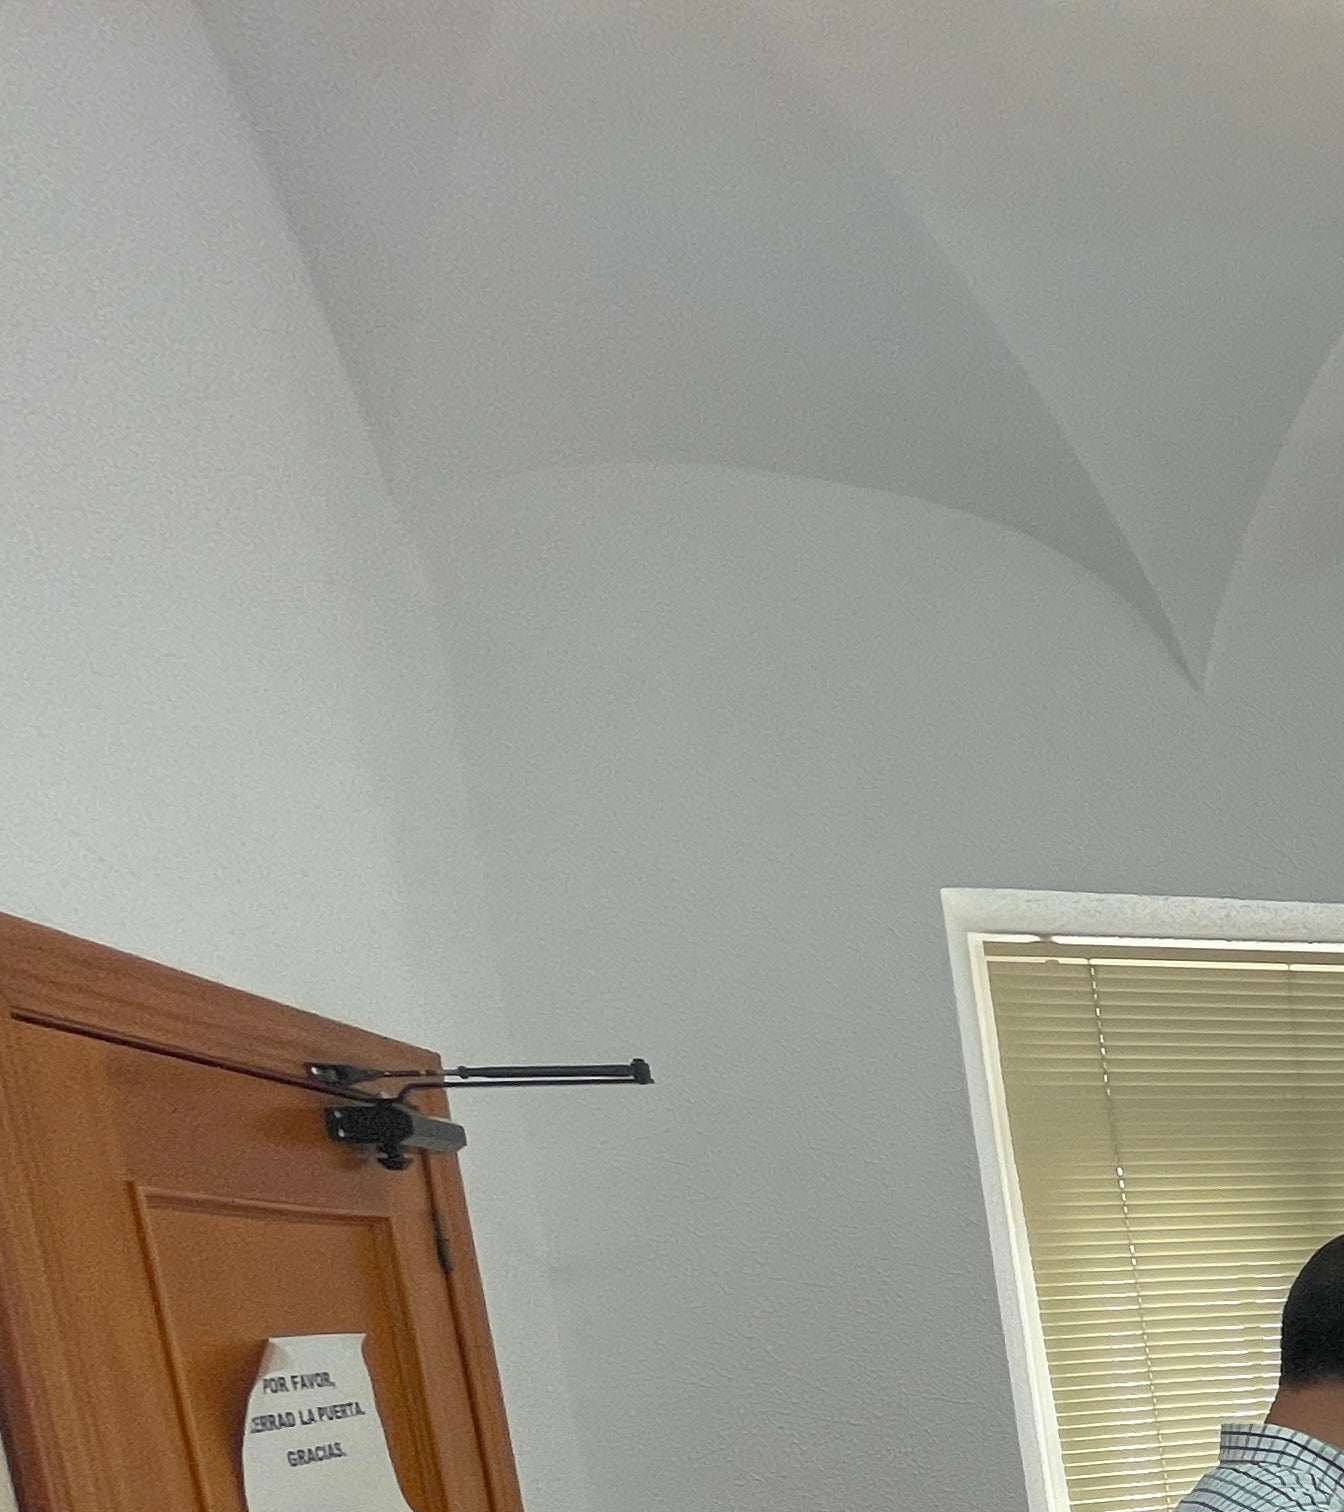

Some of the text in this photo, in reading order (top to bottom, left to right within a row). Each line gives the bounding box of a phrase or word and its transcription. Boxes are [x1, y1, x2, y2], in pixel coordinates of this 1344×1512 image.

[262, 1376, 289, 1394] POR
[250, 1412, 296, 1434] ERRAD
[299, 1408, 316, 1426] LA
